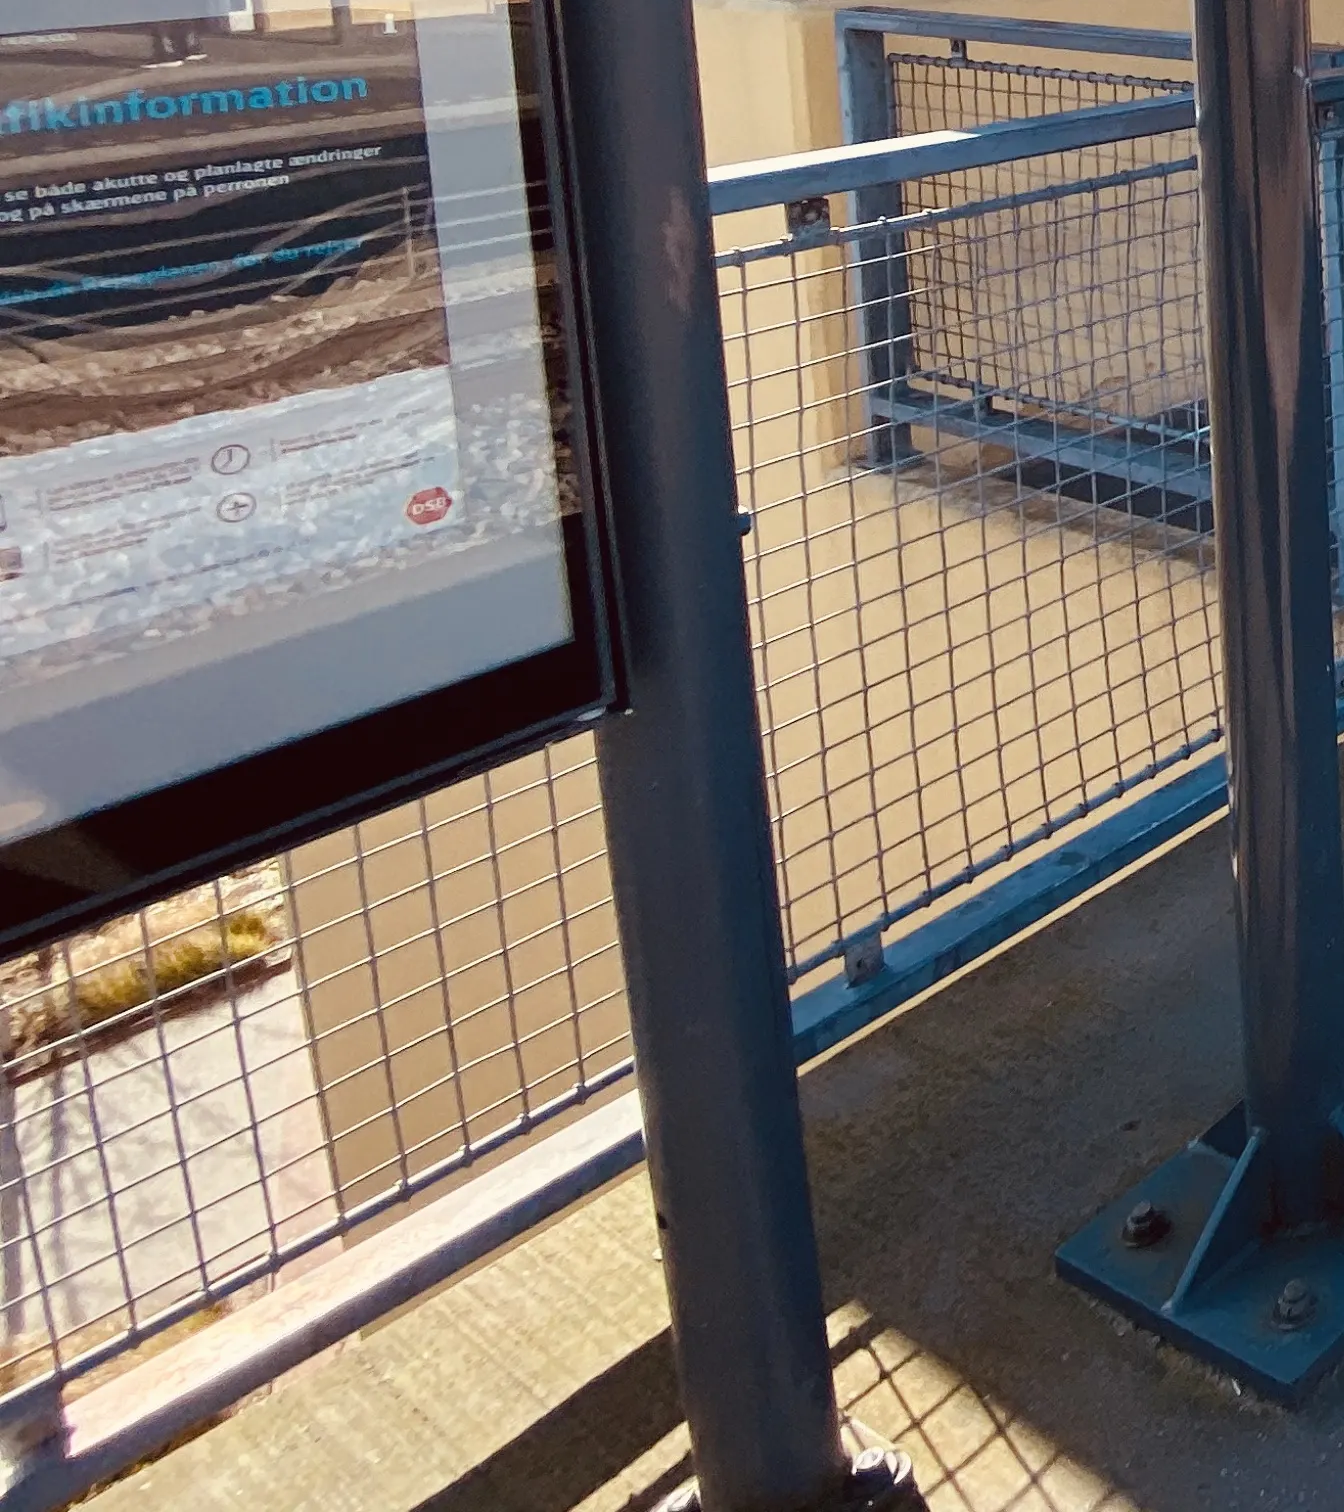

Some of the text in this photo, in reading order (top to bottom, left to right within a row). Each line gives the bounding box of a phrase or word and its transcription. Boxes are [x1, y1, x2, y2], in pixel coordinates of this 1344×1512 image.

[4, 190, 28, 202] se
[92, 173, 158, 191] akutte
[164, 169, 190, 182] og
[194, 159, 284, 180] planlagte
[288, 146, 382, 167] ændringer
[28, 201, 56, 221] på
[60, 190, 168, 214] skærmene
[173, 184, 197, 203] på
[203, 175, 290, 198] perronen
[412, 497, 447, 516] DSB
